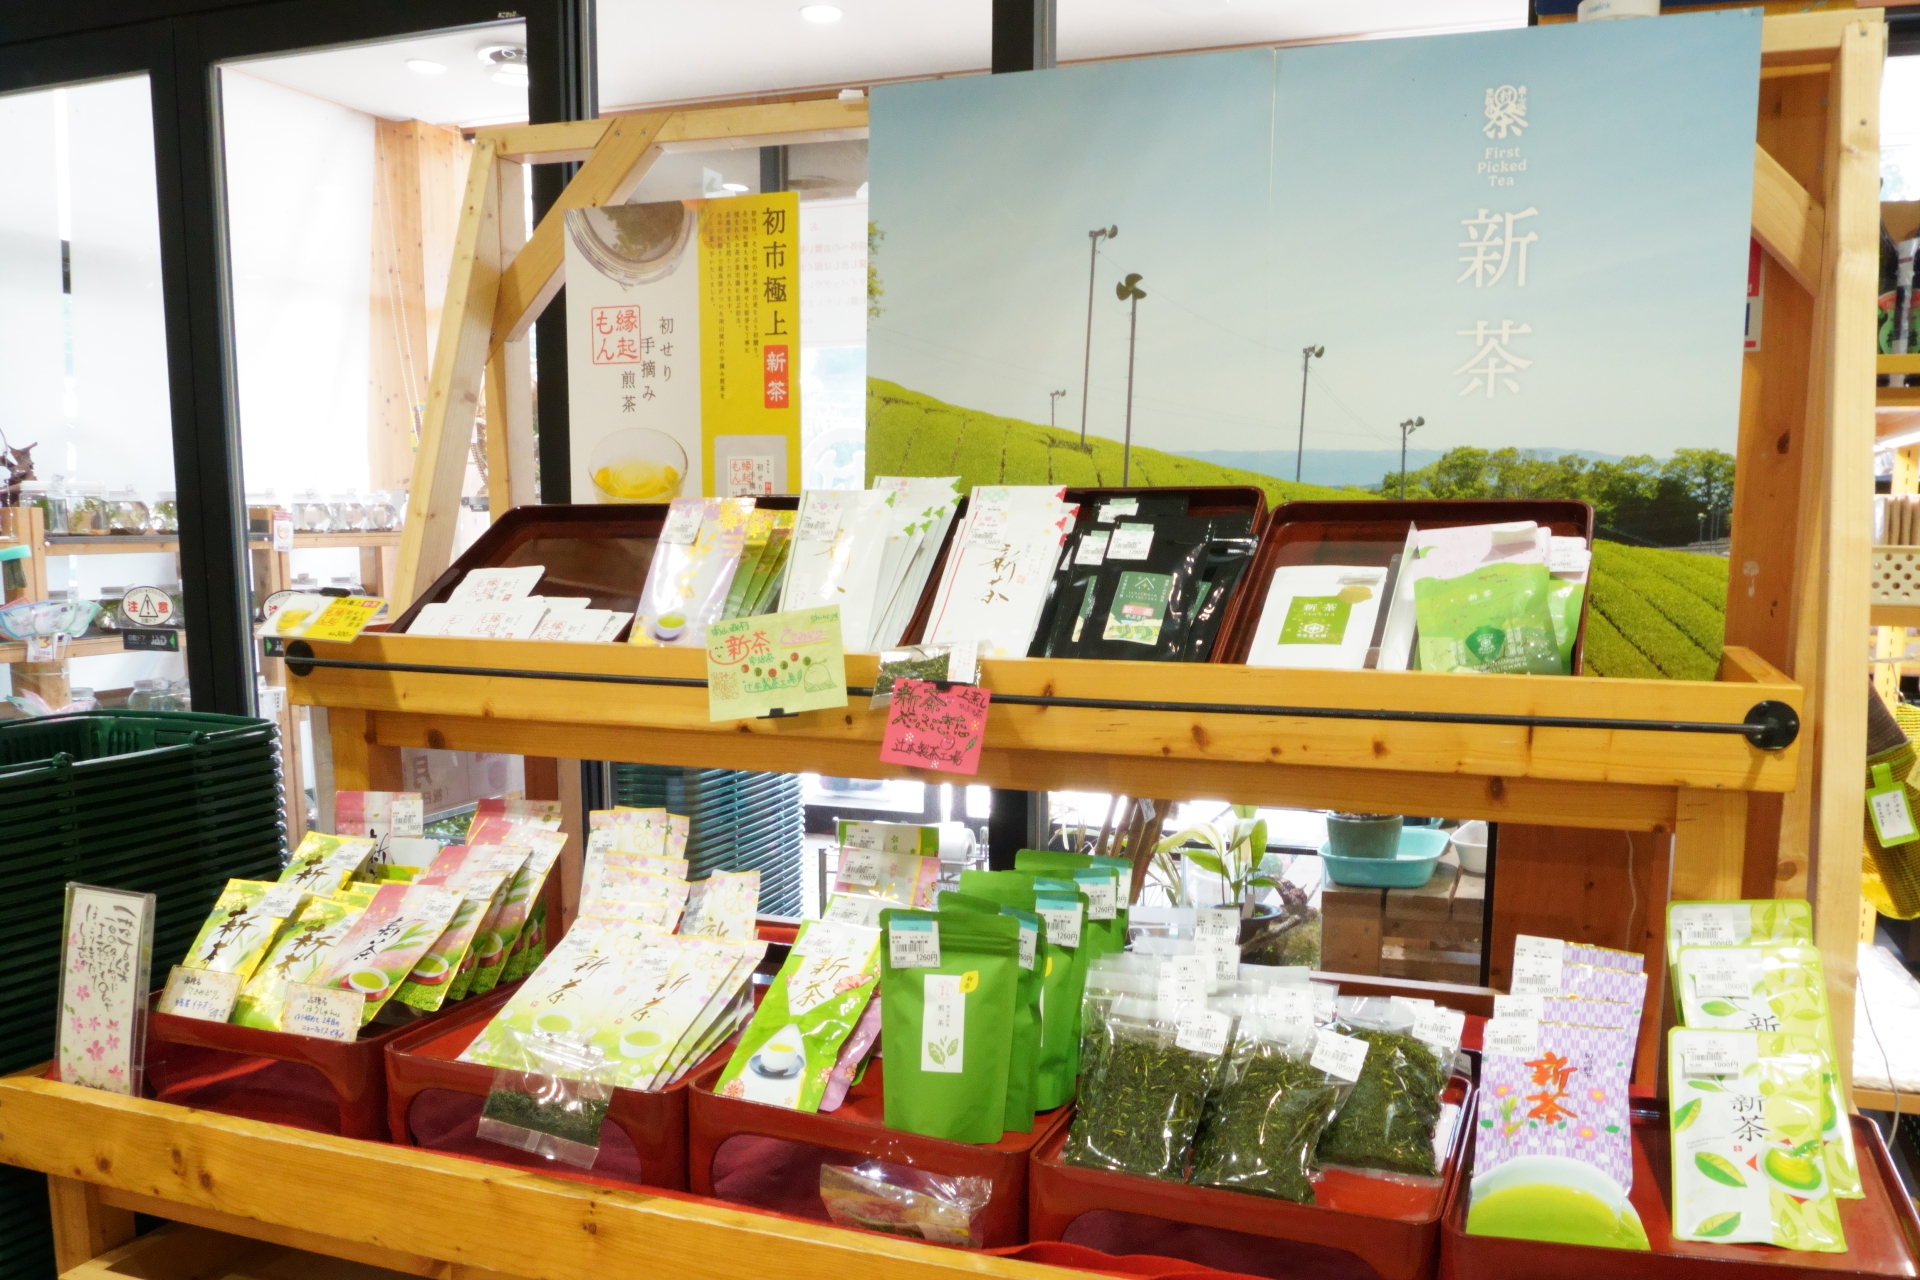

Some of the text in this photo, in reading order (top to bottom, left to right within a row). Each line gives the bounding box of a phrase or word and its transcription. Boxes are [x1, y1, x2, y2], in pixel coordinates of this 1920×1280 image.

[1477, 159, 1527, 174] Picked
[1485, 147, 1521, 159] First
[1488, 175, 1514, 187] Tea
[762, 207, 788, 403] 初市極上 新茶
[1453, 206, 1539, 399] 新茶
[595, 309, 639, 362] 縁起 もん
[658, 316, 674, 382] 初せり
[640, 336, 656, 402] 手摘み
[620, 370, 636, 414] 煎茶
[128, 600, 139, 613] 注
[724, 630, 771, 661] 新茶
[894, 681, 948, 713] 新茶
[892, 710, 970, 738] やぶきた
[1094, 906, 1115, 915] 1260円
[1056, 932, 1078, 941] 1260円
[916, 953, 938, 962] 1260円
[790, 954, 851, 1008] 新茶
[1536, 986, 1559, 994] 1000円
[1200, 1041, 1224, 1050] 1050円
[1524, 1051, 1579, 1126] 新茶
[1728, 1094, 1772, 1143] 新茶
